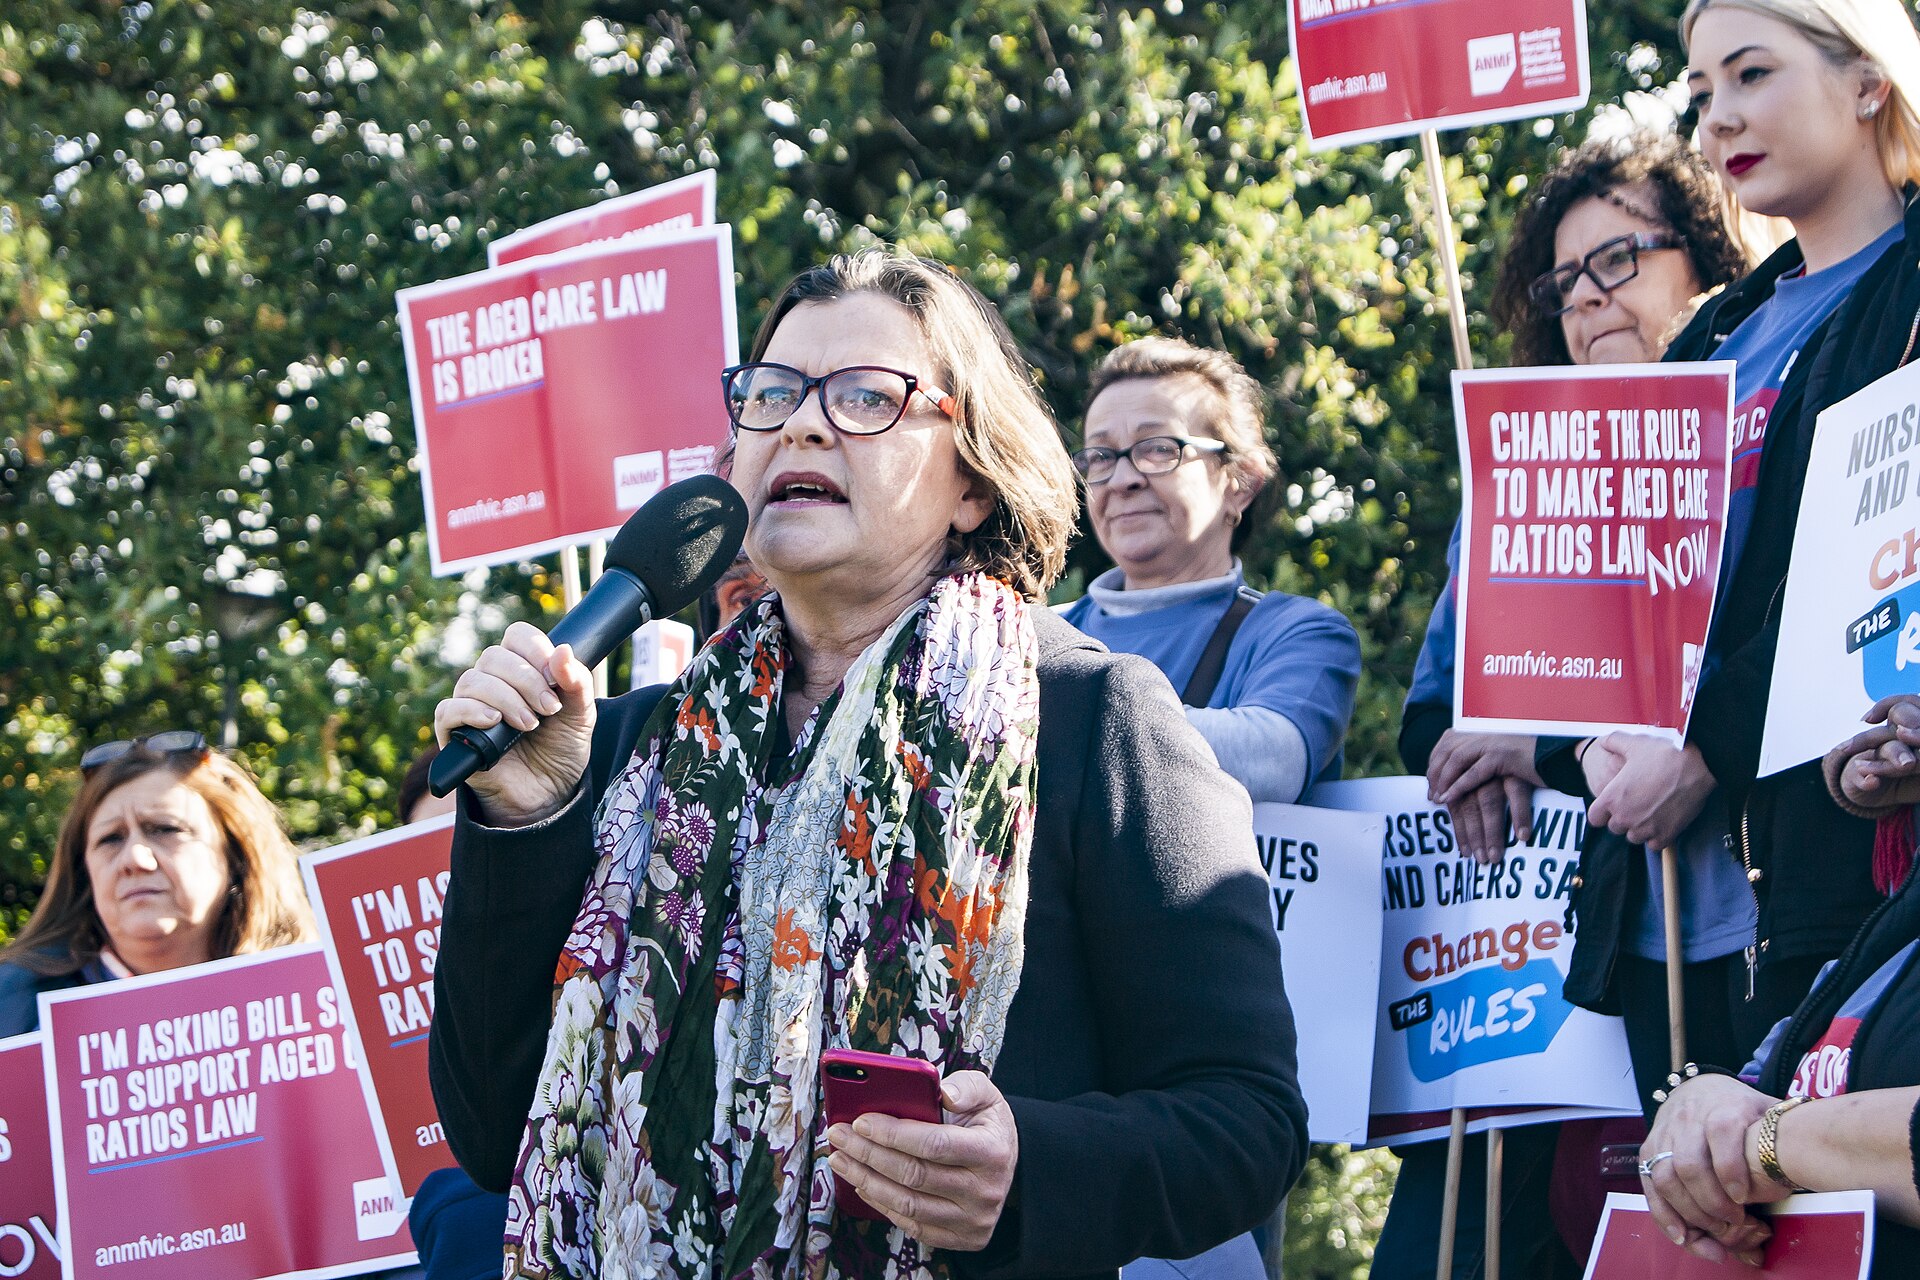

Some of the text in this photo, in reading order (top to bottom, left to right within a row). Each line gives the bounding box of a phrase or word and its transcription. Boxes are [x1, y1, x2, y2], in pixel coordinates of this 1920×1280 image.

[1308, 70, 1387, 106] anmfvic.asn.au
[1474, 51, 1513, 72] ANMF
[425, 268, 668, 359] THE AGED CARE LAW
[432, 338, 545, 404] IS BROKEN
[1489, 407, 1701, 462] CHANGE THE RULES
[1846, 403, 1920, 478] NURS
[447, 489, 546, 530] anmfvic.asn.au
[1492, 467, 1528, 519] TO
[1536, 467, 1614, 519] MAKE
[1672, 468, 1709, 521] CARE
[1854, 459, 1910, 527] AND
[1489, 524, 1646, 576] RATIOS LAW
[1646, 525, 1710, 597] NOW
[1852, 606, 1891, 643] THE
[1482, 650, 1623, 680] anmfvic.asn.au
[1383, 864, 1425, 910] ND
[1535, 856, 1579, 900] SA
[351, 884, 413, 940] I'M
[363, 938, 411, 987] TO
[1404, 919, 1562, 982] Change
[78, 1027, 128, 1076] I'M
[137, 1004, 240, 1066] ASKING
[246, 992, 311, 1042] BILL
[1396, 997, 1428, 1022] THE
[1429, 982, 1548, 1055] RULES
[81, 1078, 119, 1119] TO
[128, 1048, 251, 1108] SUPPORT
[259, 1032, 336, 1085] AGED
[86, 1092, 259, 1165] RATIOS LAW
[95, 1221, 247, 1267] anmfvic.asn.au
